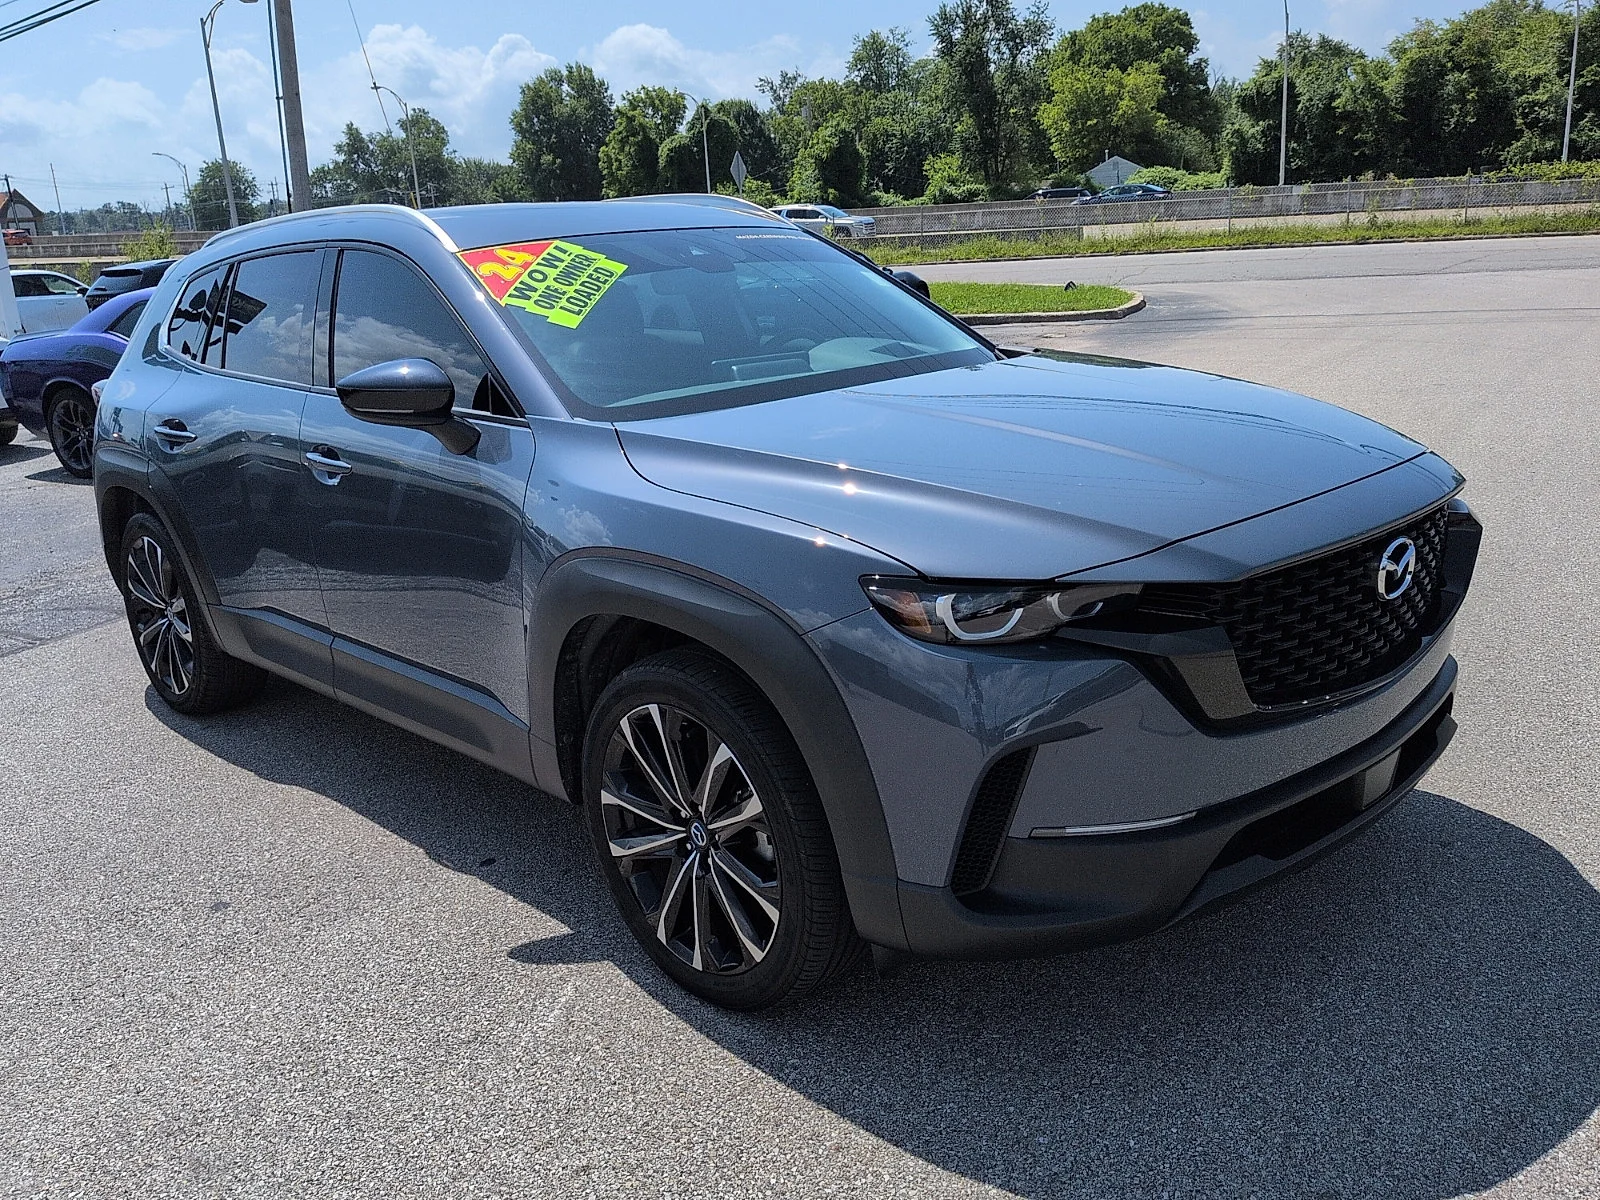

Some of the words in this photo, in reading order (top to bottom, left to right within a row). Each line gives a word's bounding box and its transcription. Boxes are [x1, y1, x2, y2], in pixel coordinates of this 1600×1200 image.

[476, 249, 536, 281] 24
[533, 284, 567, 310] ONE
[552, 253, 597, 287] OWNER
[559, 266, 615, 316] LOADED
